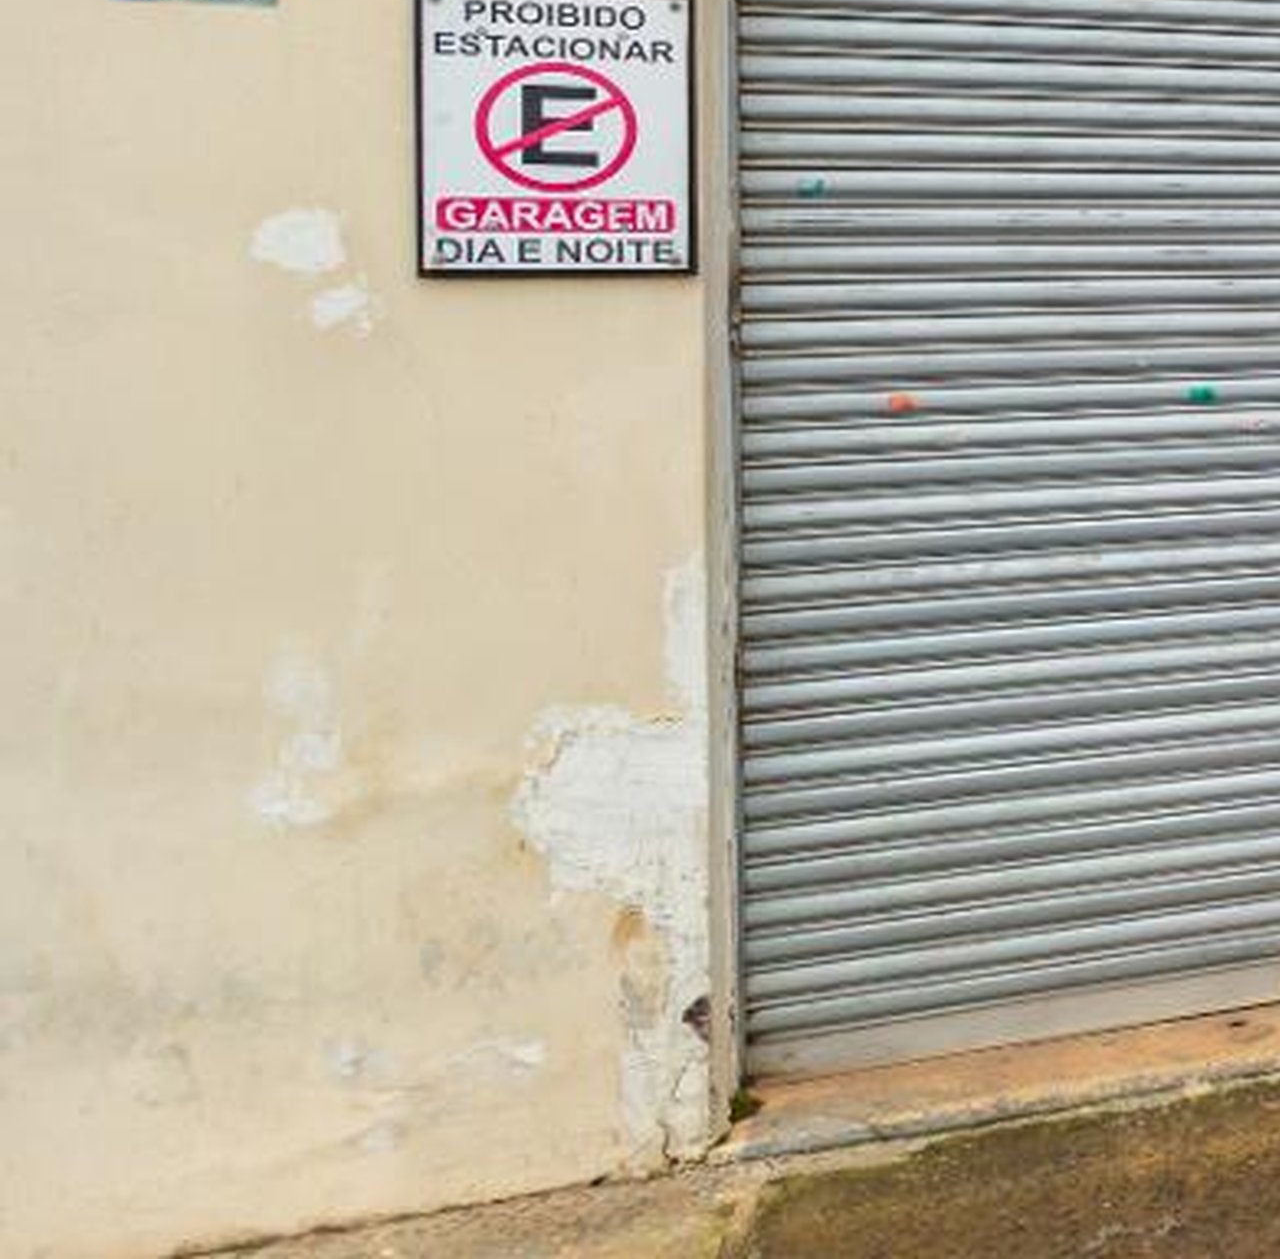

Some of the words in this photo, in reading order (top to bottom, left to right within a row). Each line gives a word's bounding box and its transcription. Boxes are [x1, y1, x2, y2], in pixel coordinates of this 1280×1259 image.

[463, 0, 646, 30] PROIBIDO
[433, 32, 675, 63] ESTACIONAR
[445, 201, 669, 230] GARAGEM
[436, 238, 506, 264] DIA
[517, 238, 542, 264] E
[556, 238, 675, 264] NOITE
